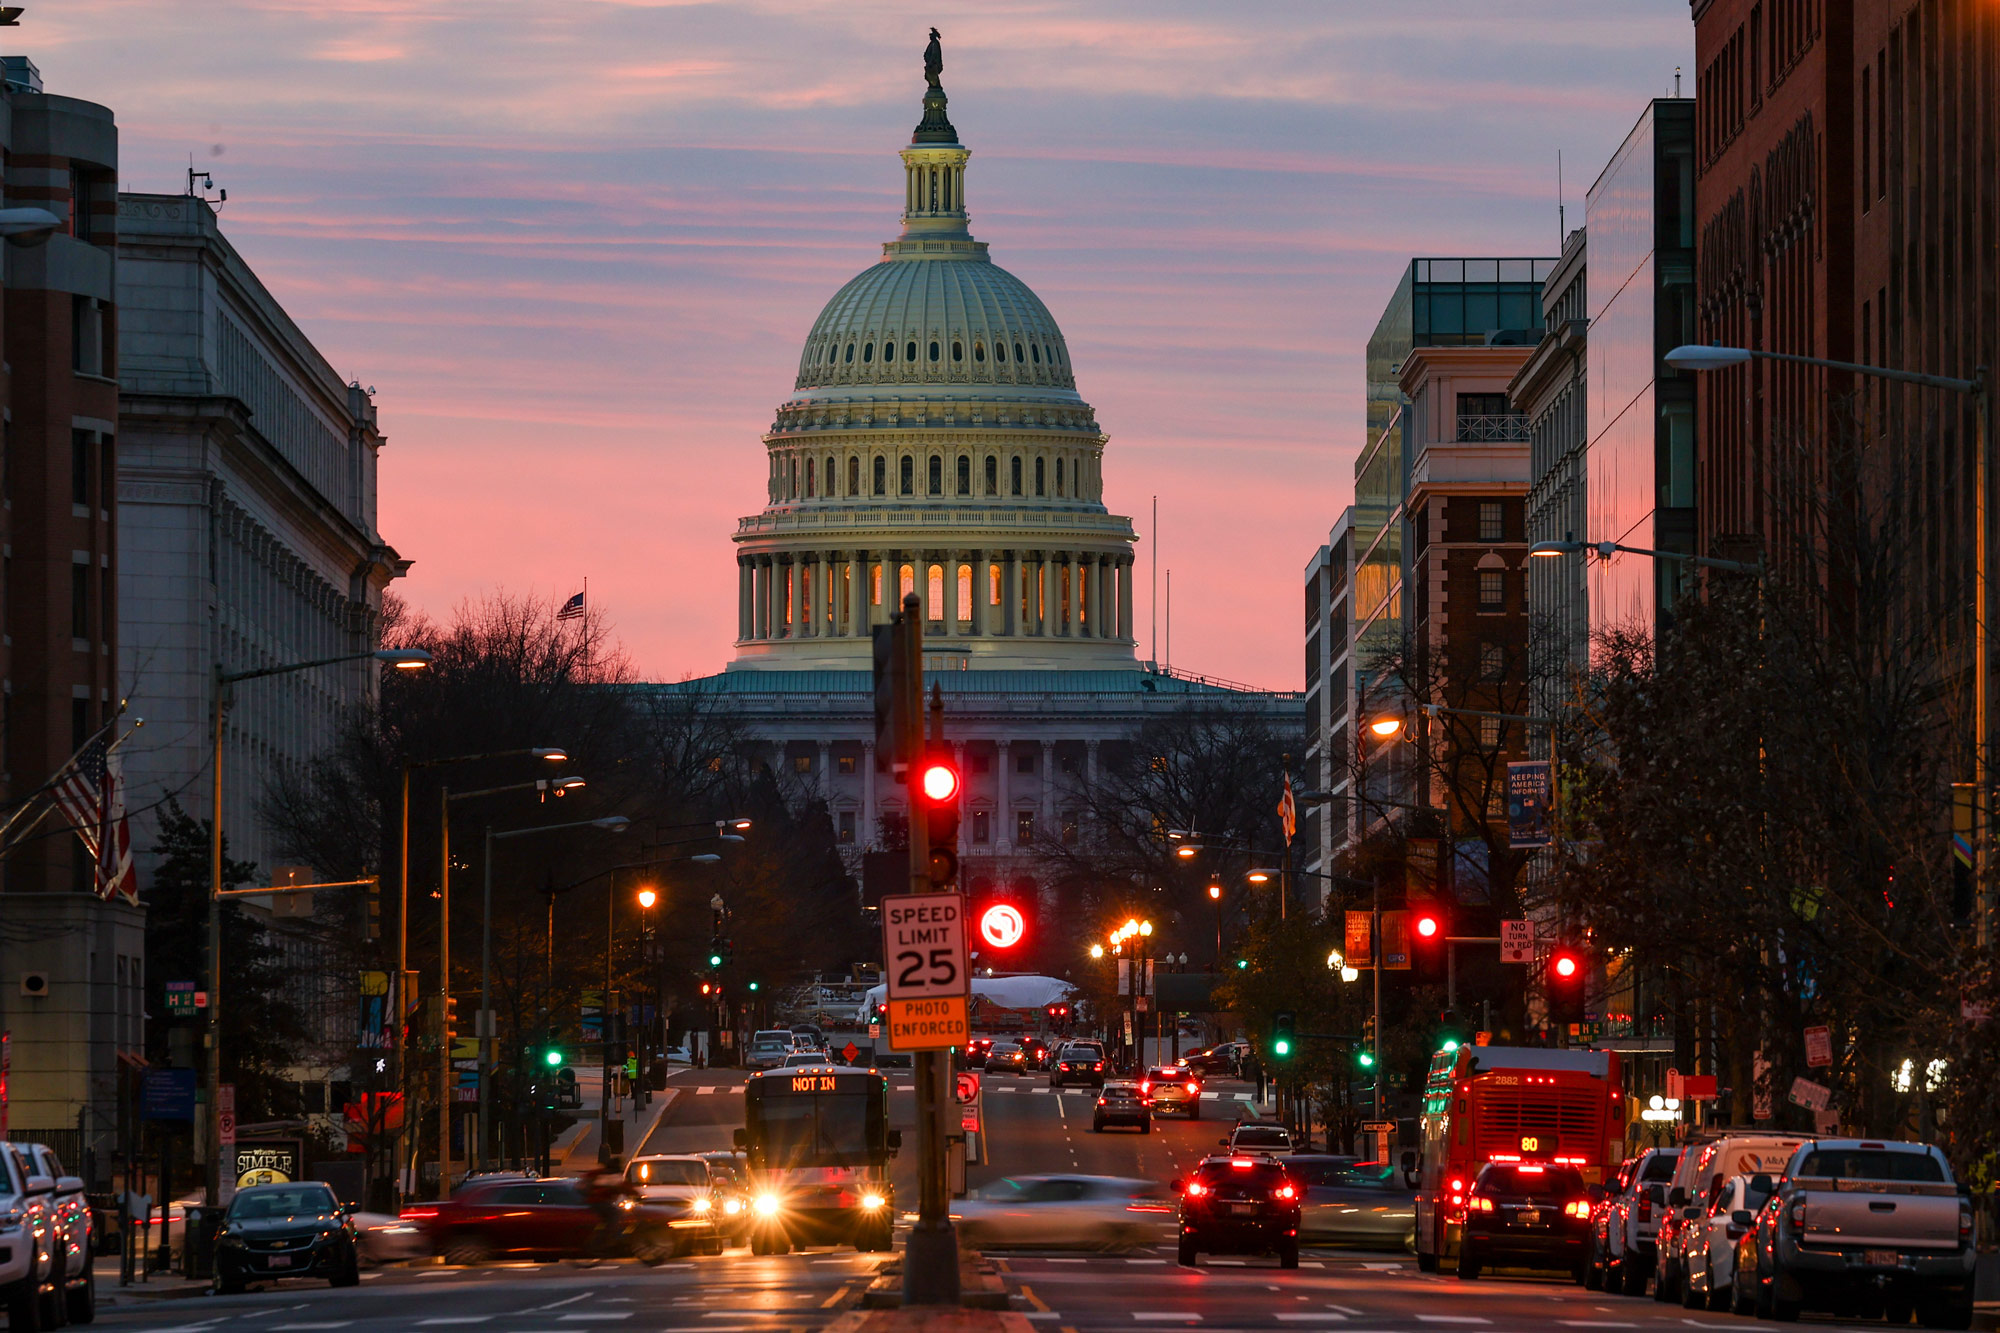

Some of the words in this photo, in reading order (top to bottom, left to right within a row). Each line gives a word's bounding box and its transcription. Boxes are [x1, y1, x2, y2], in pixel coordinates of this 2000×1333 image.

[1511, 773, 1545, 781] KEEPING
[890, 906, 957, 925] SPEED
[1511, 923, 1525, 931] NO
[898, 927, 950, 946] LIMIT
[1509, 932, 1528, 940] TURN
[896, 949, 957, 988] 25
[168, 993, 179, 1006] H
[174, 1007, 197, 1015] UNIT
[905, 1001, 950, 1017] PHOTO
[893, 1020, 964, 1037] ENFORCED
[1582, 1023, 1589, 1034] H
[792, 1076, 817, 1092] NOT
[820, 1076, 836, 1091] IN
[1495, 1076, 1519, 1086] 2882
[1521, 1136, 1538, 1152] 80
[236, 1155, 292, 1175] SIMPLE
[1765, 1156, 1785, 1165] A&A
